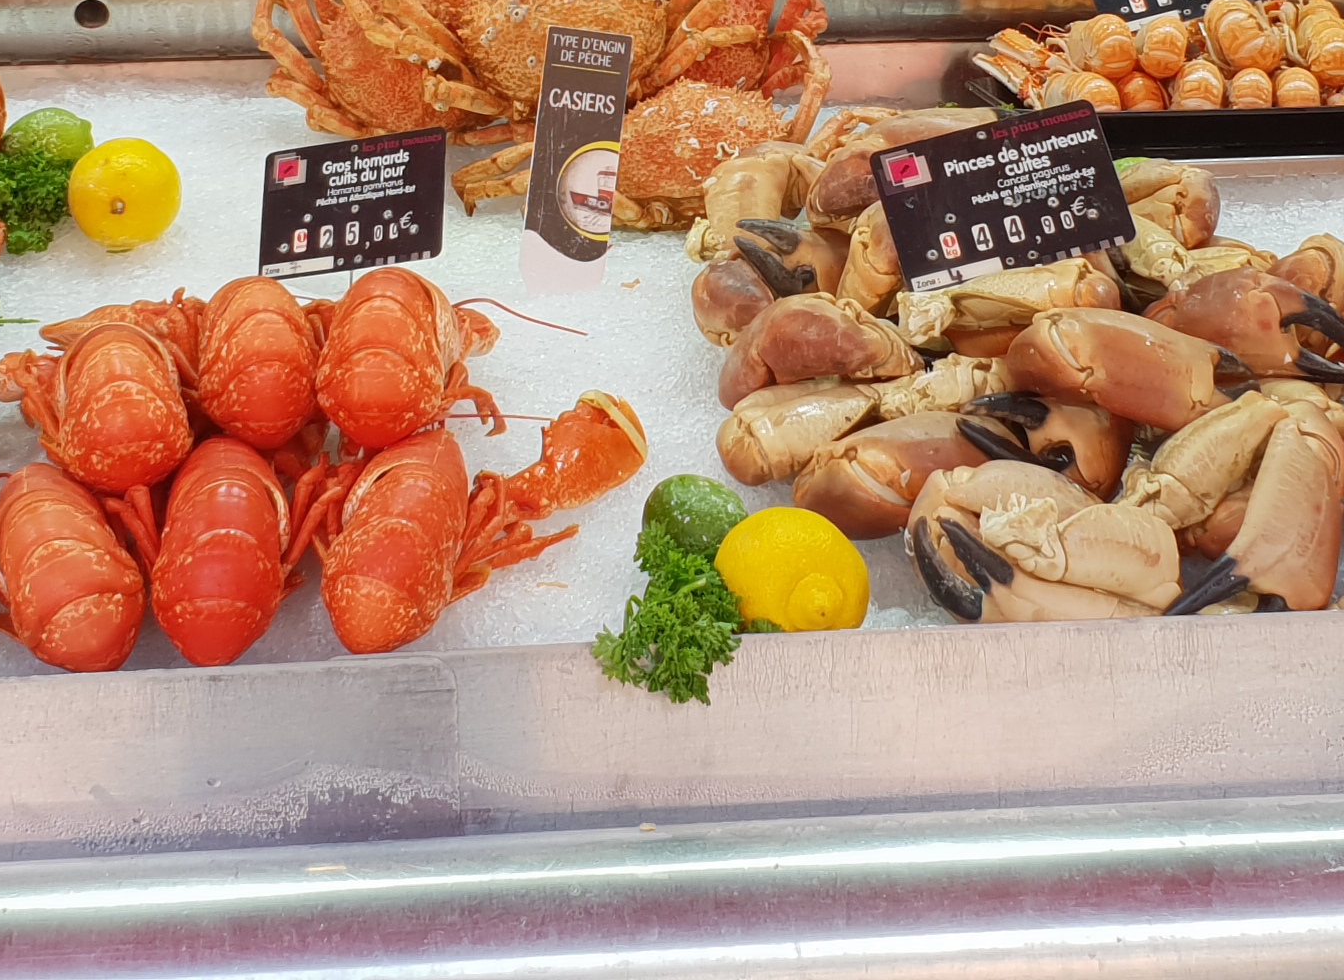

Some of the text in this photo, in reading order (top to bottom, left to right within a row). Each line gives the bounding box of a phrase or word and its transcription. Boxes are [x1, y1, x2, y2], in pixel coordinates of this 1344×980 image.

[552, 33, 626, 55] TYPE D'ENGIN
[560, 49, 613, 68] DE PÊCHE
[549, 87, 616, 115] CASIERS
[322, 149, 410, 175] Gros homards
[943, 128, 1099, 178] Pinces de tourteaux
[329, 165, 406, 187] cuits du jour
[997, 164, 1071, 188] Cancer pagurus
[1005, 155, 1051, 176] cuites
[1000, 188, 1013, 198] en
[1013, 179, 1057, 194] Atlantique
[1058, 166, 1096, 183] Nord-Est
